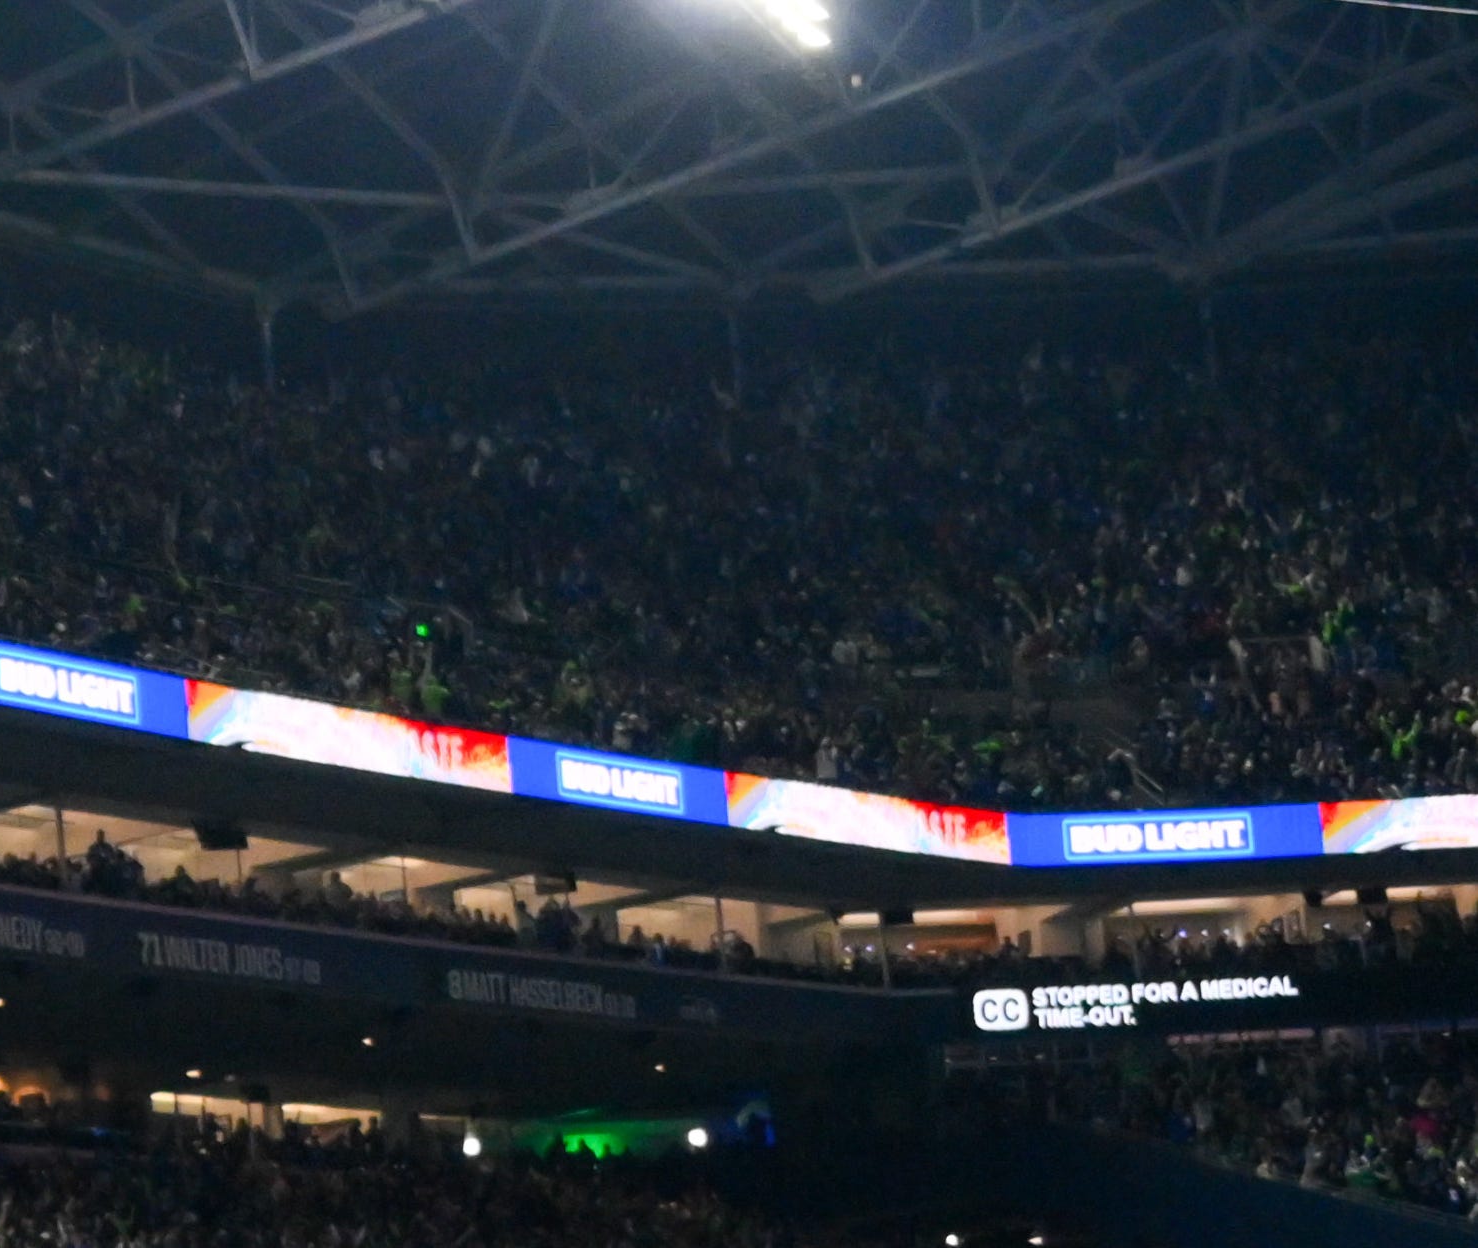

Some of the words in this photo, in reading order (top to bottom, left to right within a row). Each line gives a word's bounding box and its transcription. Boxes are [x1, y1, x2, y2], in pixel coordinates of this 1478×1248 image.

[57, 669, 134, 714] LIGHT
[561, 759, 610, 795] BUD
[610, 768, 678, 805] LIGHT
[1069, 824, 1143, 853] BUD
[1144, 820, 1245, 850] LIGHT
[164, 935, 230, 974] WALTER
[234, 943, 283, 980] JONES
[1033, 984, 1128, 1008] STOPPED
[1131, 982, 1178, 1004] FOR
[1180, 980, 1199, 1001] A
[1200, 976, 1298, 1000] MEDICAL
[1033, 1006, 1138, 1028] TIME-OUT.
